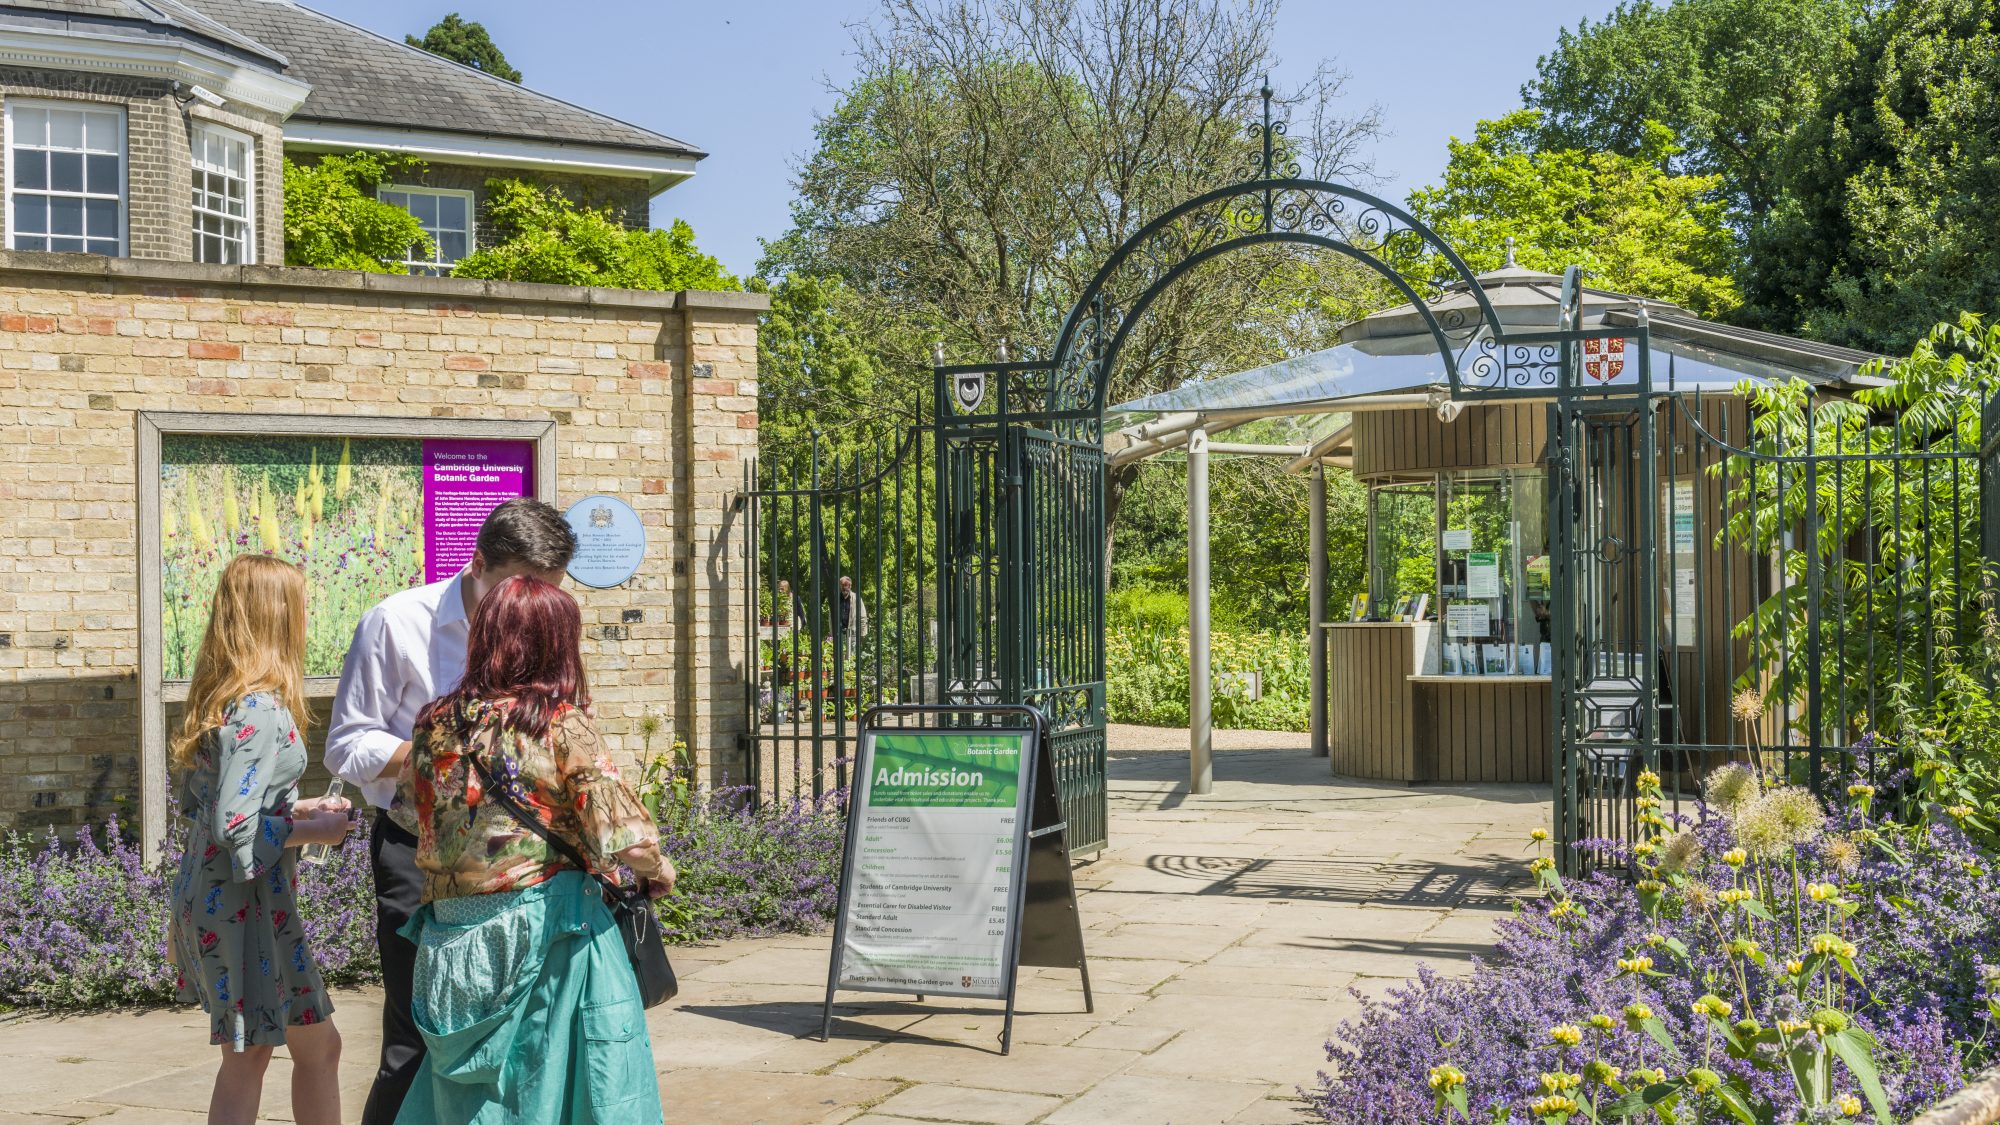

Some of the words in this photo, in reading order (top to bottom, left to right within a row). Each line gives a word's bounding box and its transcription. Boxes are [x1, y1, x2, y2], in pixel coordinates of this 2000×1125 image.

[434, 464, 480, 472] Cambridge
[482, 464, 524, 473] University
[875, 767, 983, 786] Admission
[886, 976, 906, 984] helping
